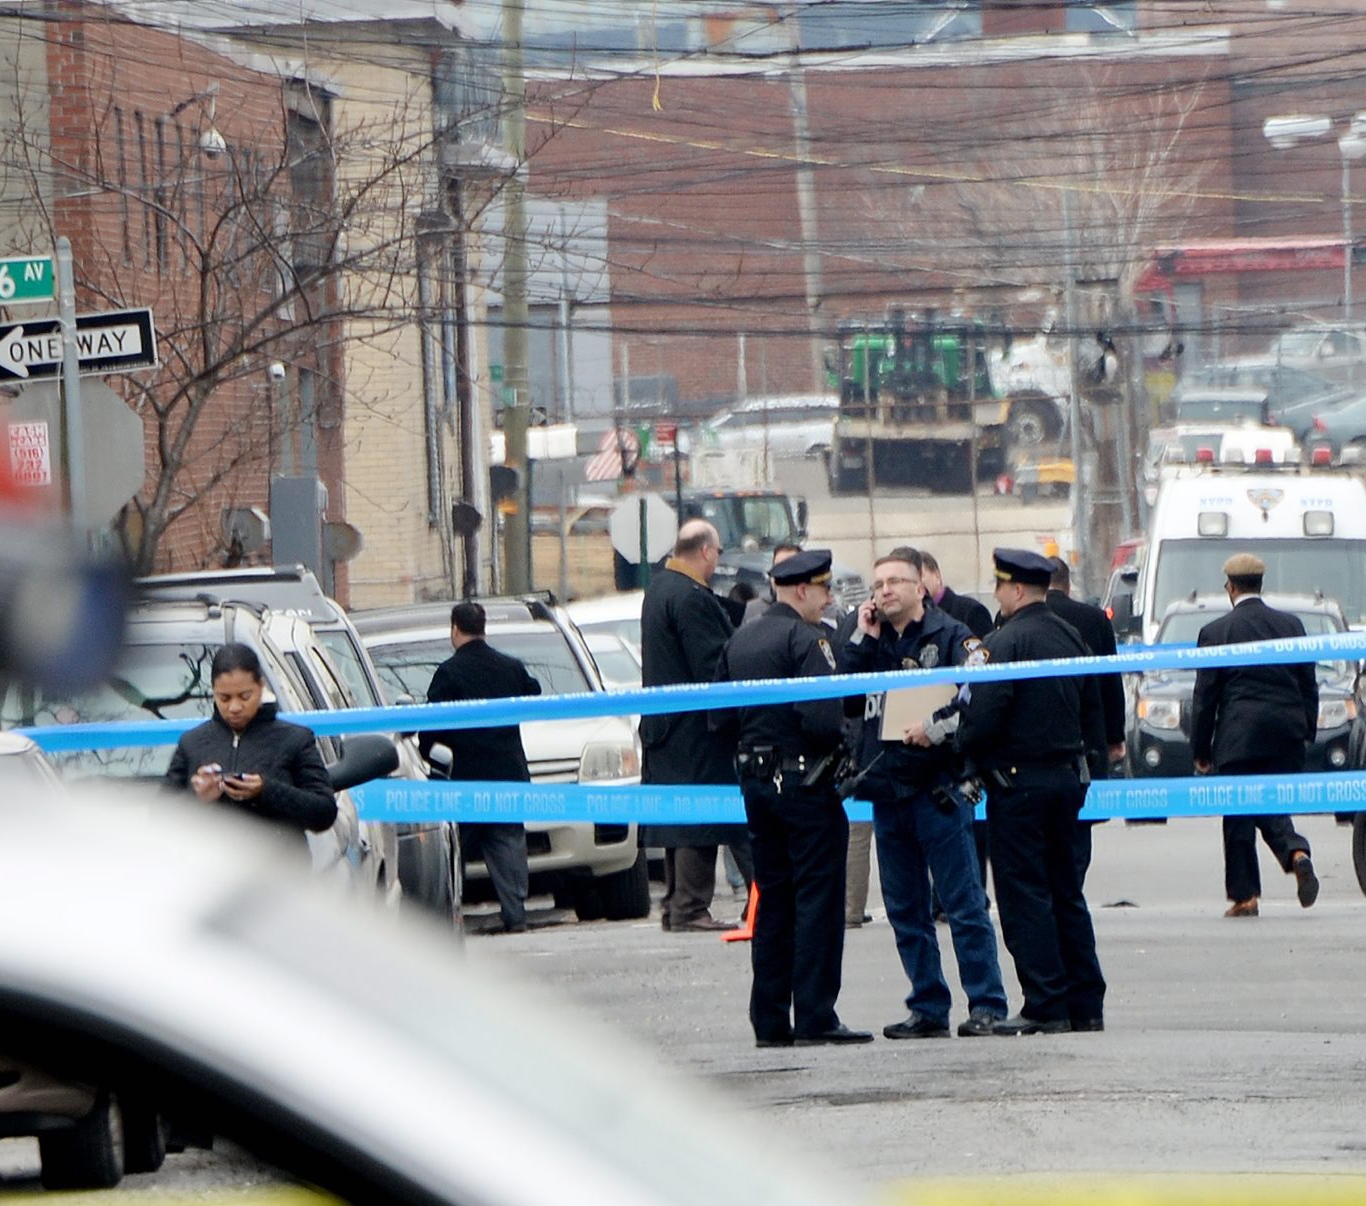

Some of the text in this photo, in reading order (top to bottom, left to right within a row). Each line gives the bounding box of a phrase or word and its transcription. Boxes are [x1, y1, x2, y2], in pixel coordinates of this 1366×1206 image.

[24, 262, 44, 282] AV
[10, 330, 127, 363] ONE WAY
[386, 790, 431, 813] POLICE
[436, 792, 463, 813] LINE
[495, 792, 520, 814] NOT
[524, 793, 566, 814] CROSS
[1126, 788, 1168, 808] CROSS
[1189, 785, 1233, 807] POLICE
[1237, 783, 1265, 805] LINE
[1298, 781, 1325, 803] NOT
